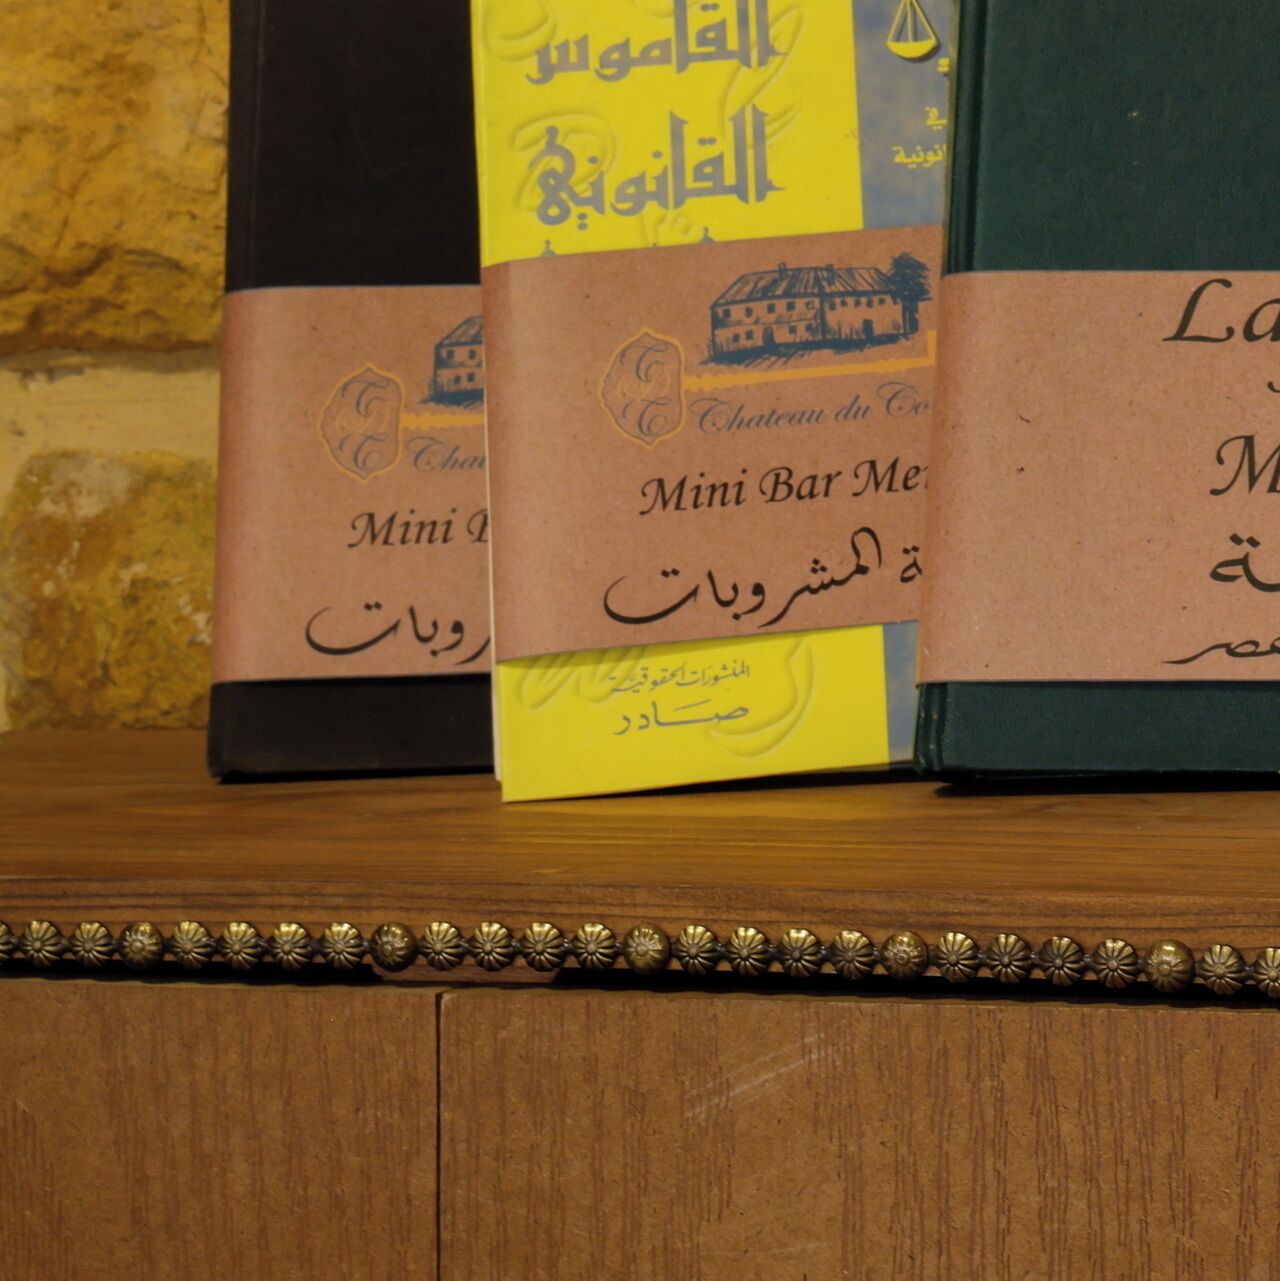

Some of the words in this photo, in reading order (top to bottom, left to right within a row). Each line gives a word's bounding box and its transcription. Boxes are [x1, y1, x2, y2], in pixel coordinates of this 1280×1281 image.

[527, 103, 785, 231] القانوني
[834, 393, 872, 422] du
[639, 468, 747, 516] Mini
[758, 466, 843, 504] Bar
[347, 507, 456, 549] Mini
[604, 526, 882, 628] المشروبات
